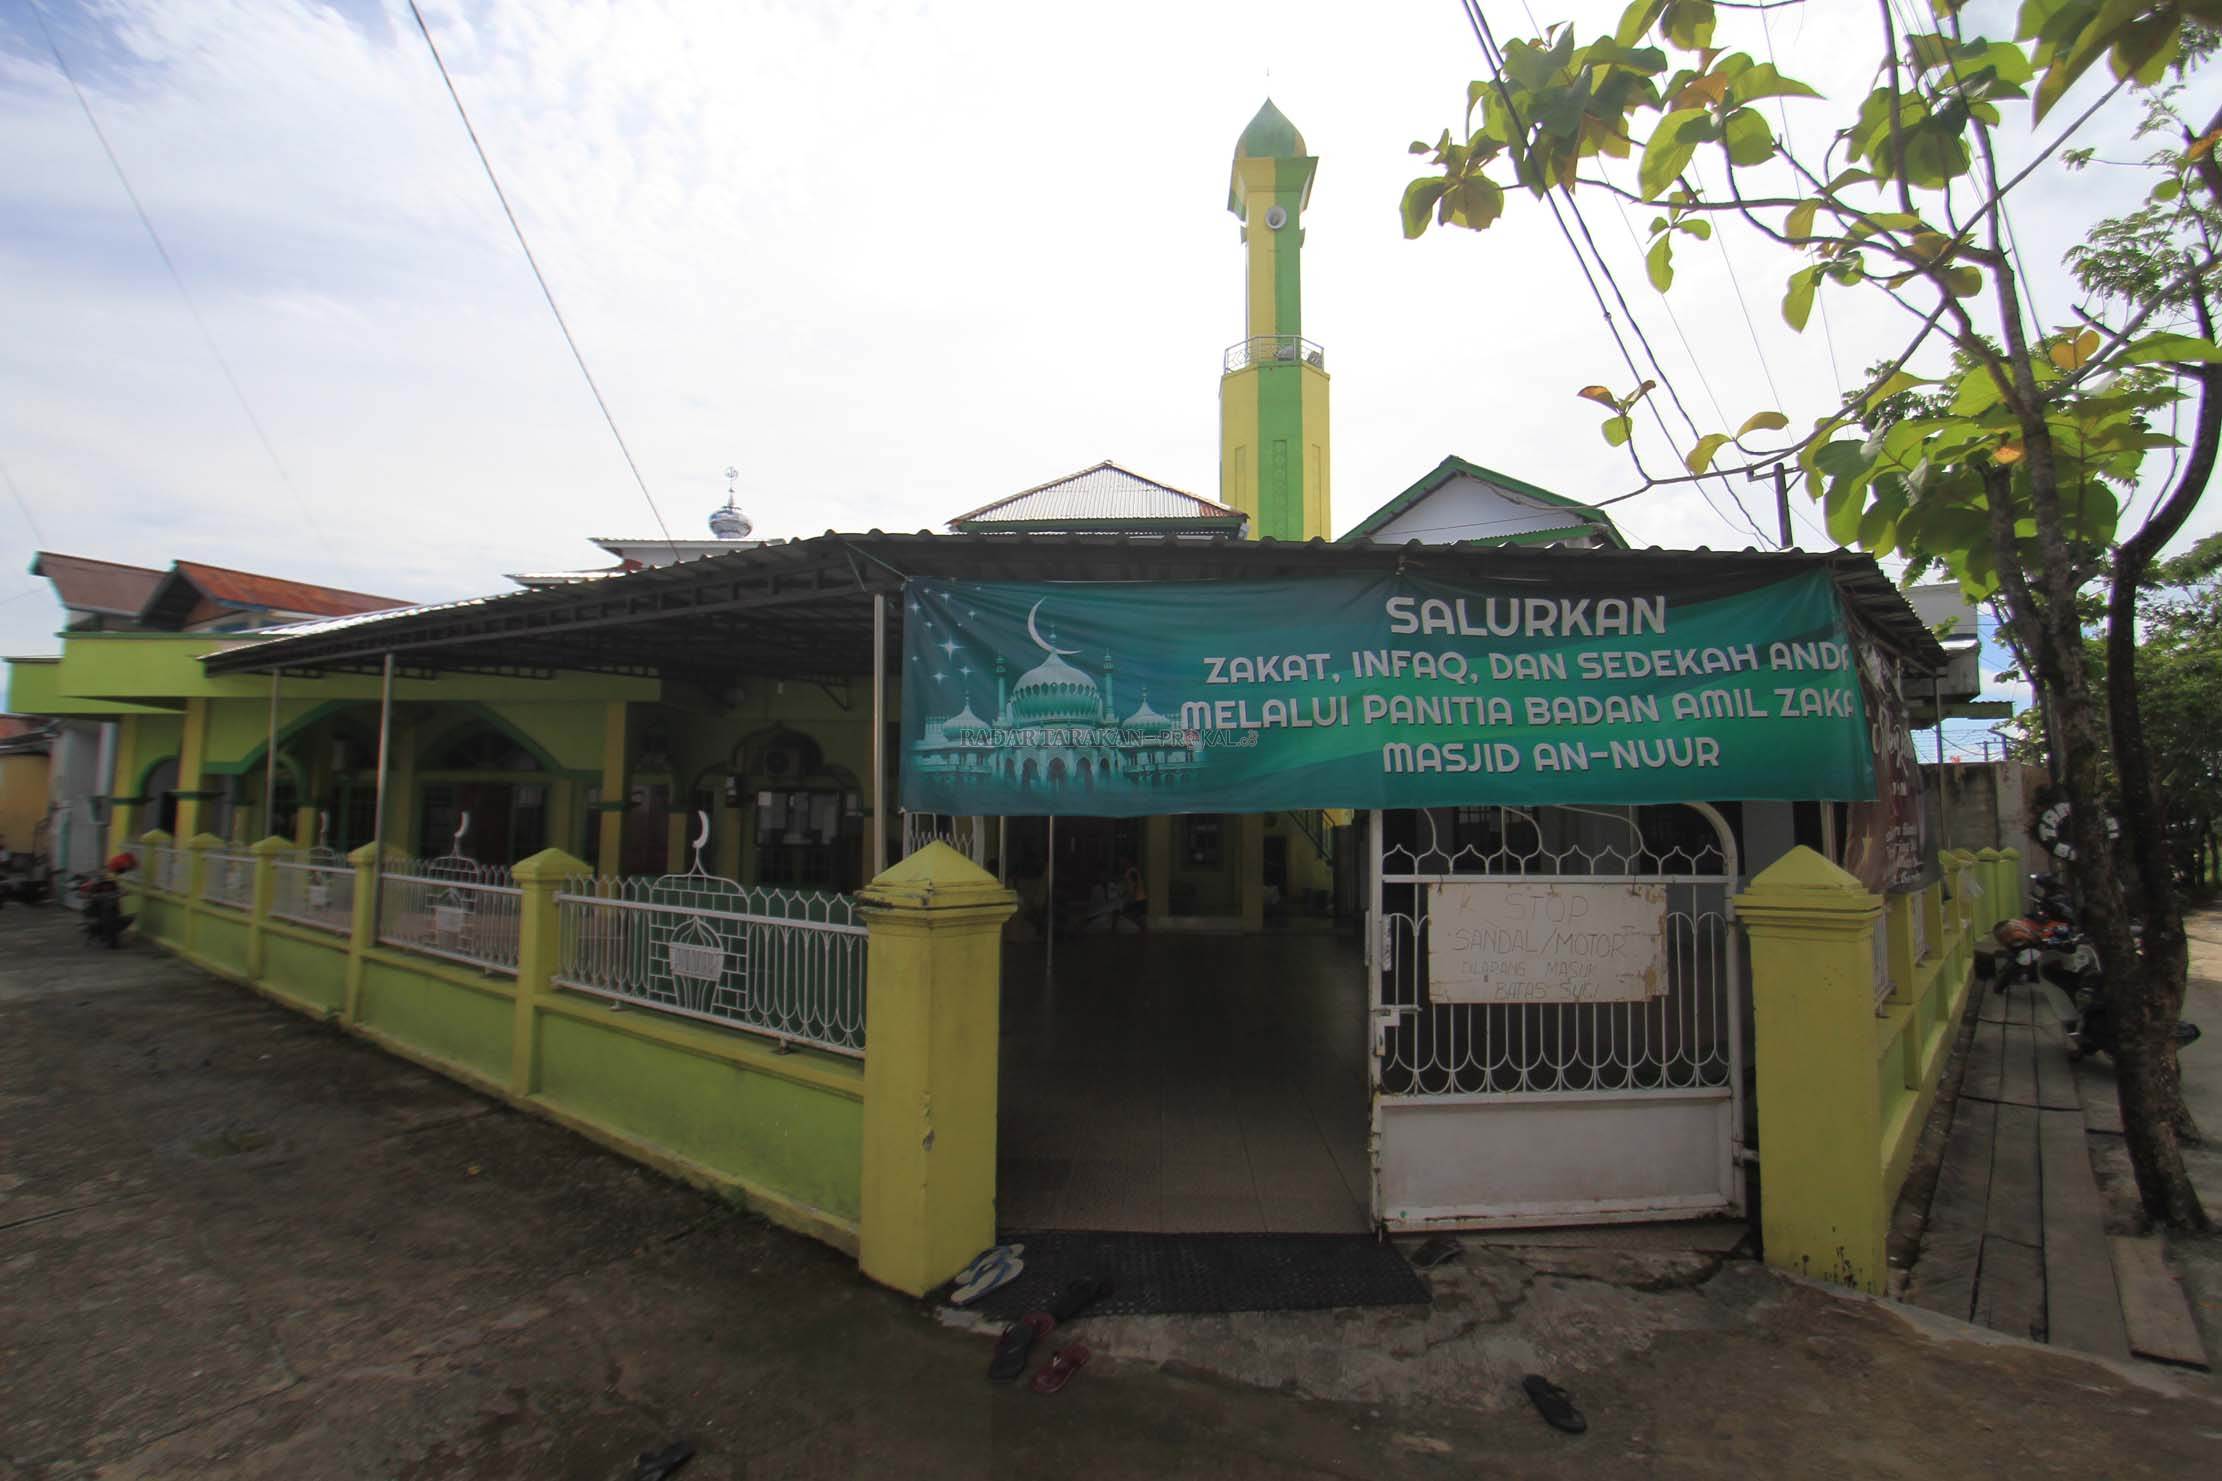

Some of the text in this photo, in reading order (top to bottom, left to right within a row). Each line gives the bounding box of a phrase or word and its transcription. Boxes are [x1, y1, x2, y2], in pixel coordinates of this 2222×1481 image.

[1385, 595, 1666, 637] SALURKAN
[1203, 653, 1342, 684] ZAKAT,
[1352, 649, 1479, 685] INFAQ,
[1488, 652, 1567, 680] DAN
[1577, 643, 1757, 680] SEDEKAH
[1180, 695, 1348, 729] MELALUI
[1362, 694, 1514, 726] PANITIA
[1525, 694, 1660, 726] BADAN
[1672, 688, 1768, 720] AMIL
[1383, 736, 1720, 773] MASJID AN-NUUR
[1502, 892, 1590, 923] STOP
[1495, 982, 1547, 1000] BATAS
